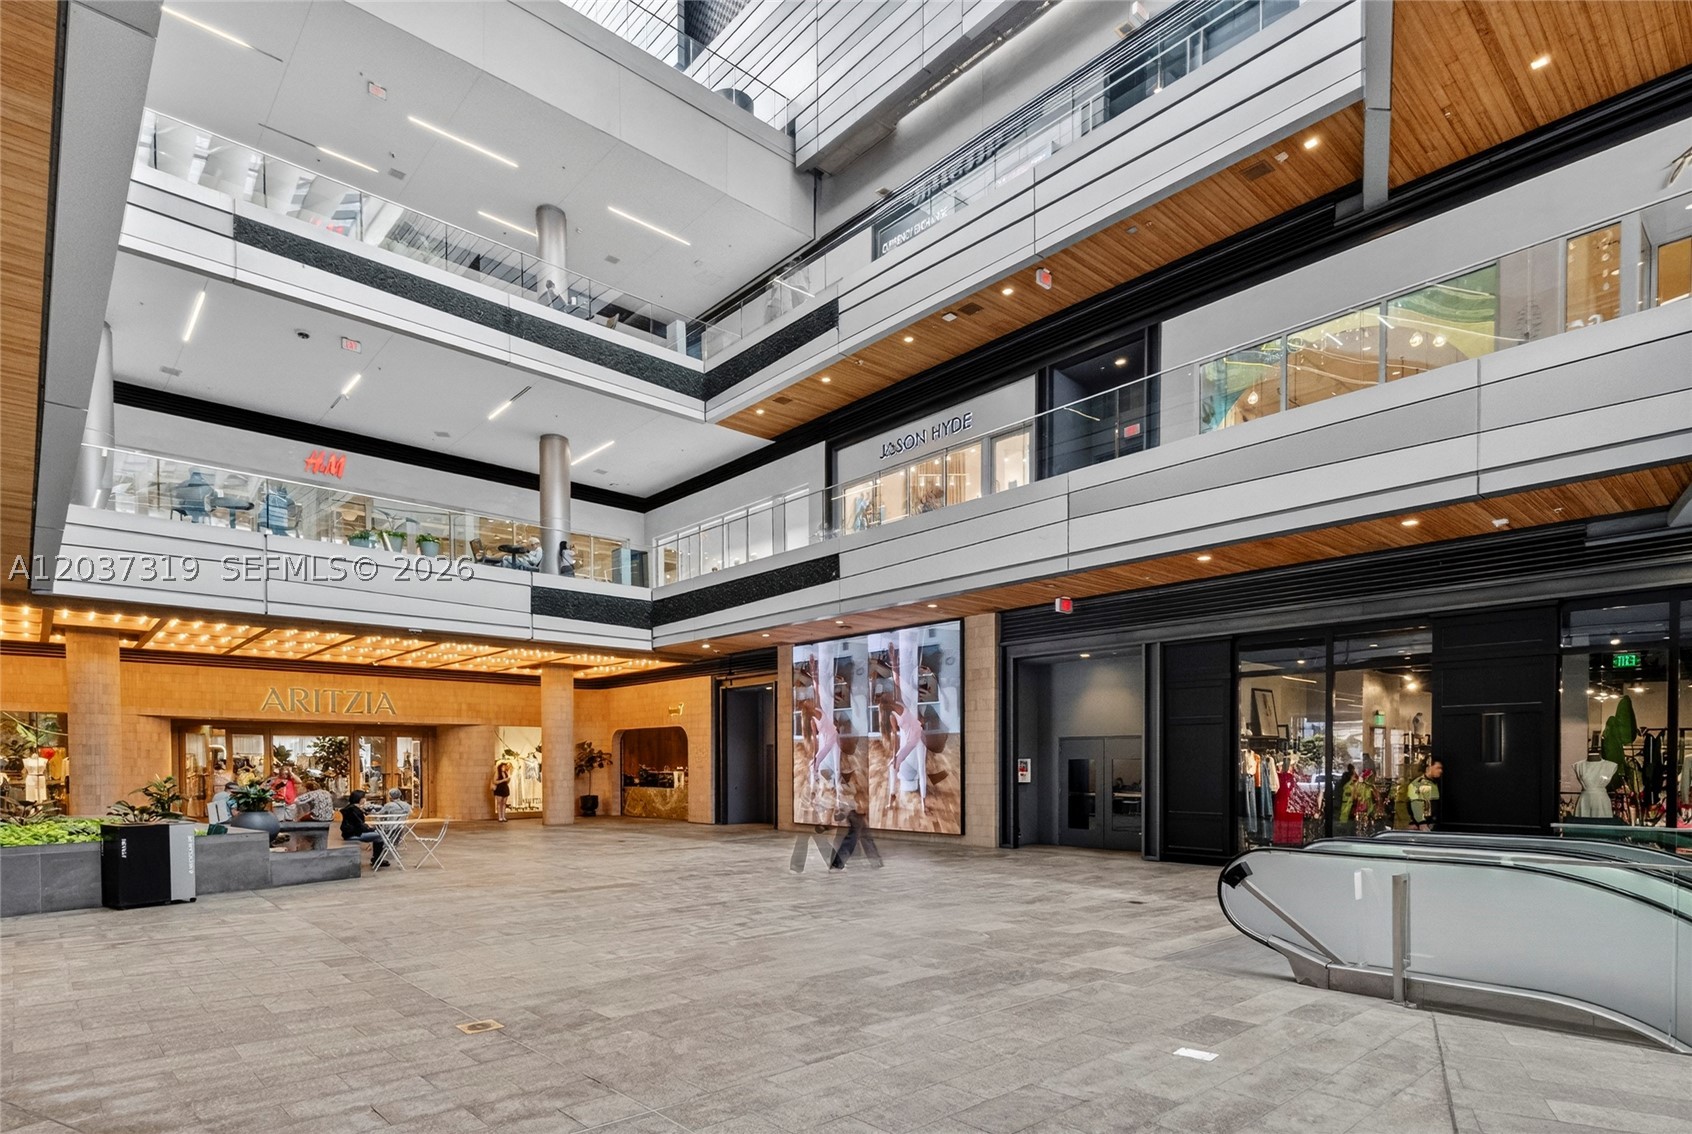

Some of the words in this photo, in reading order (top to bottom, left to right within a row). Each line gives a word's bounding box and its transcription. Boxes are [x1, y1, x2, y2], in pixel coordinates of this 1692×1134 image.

[879, 429, 927, 459] JASON
[931, 412, 973, 441] HYDE
[304, 449, 346, 480] H&M
[260, 686, 397, 716] ARITZIA
